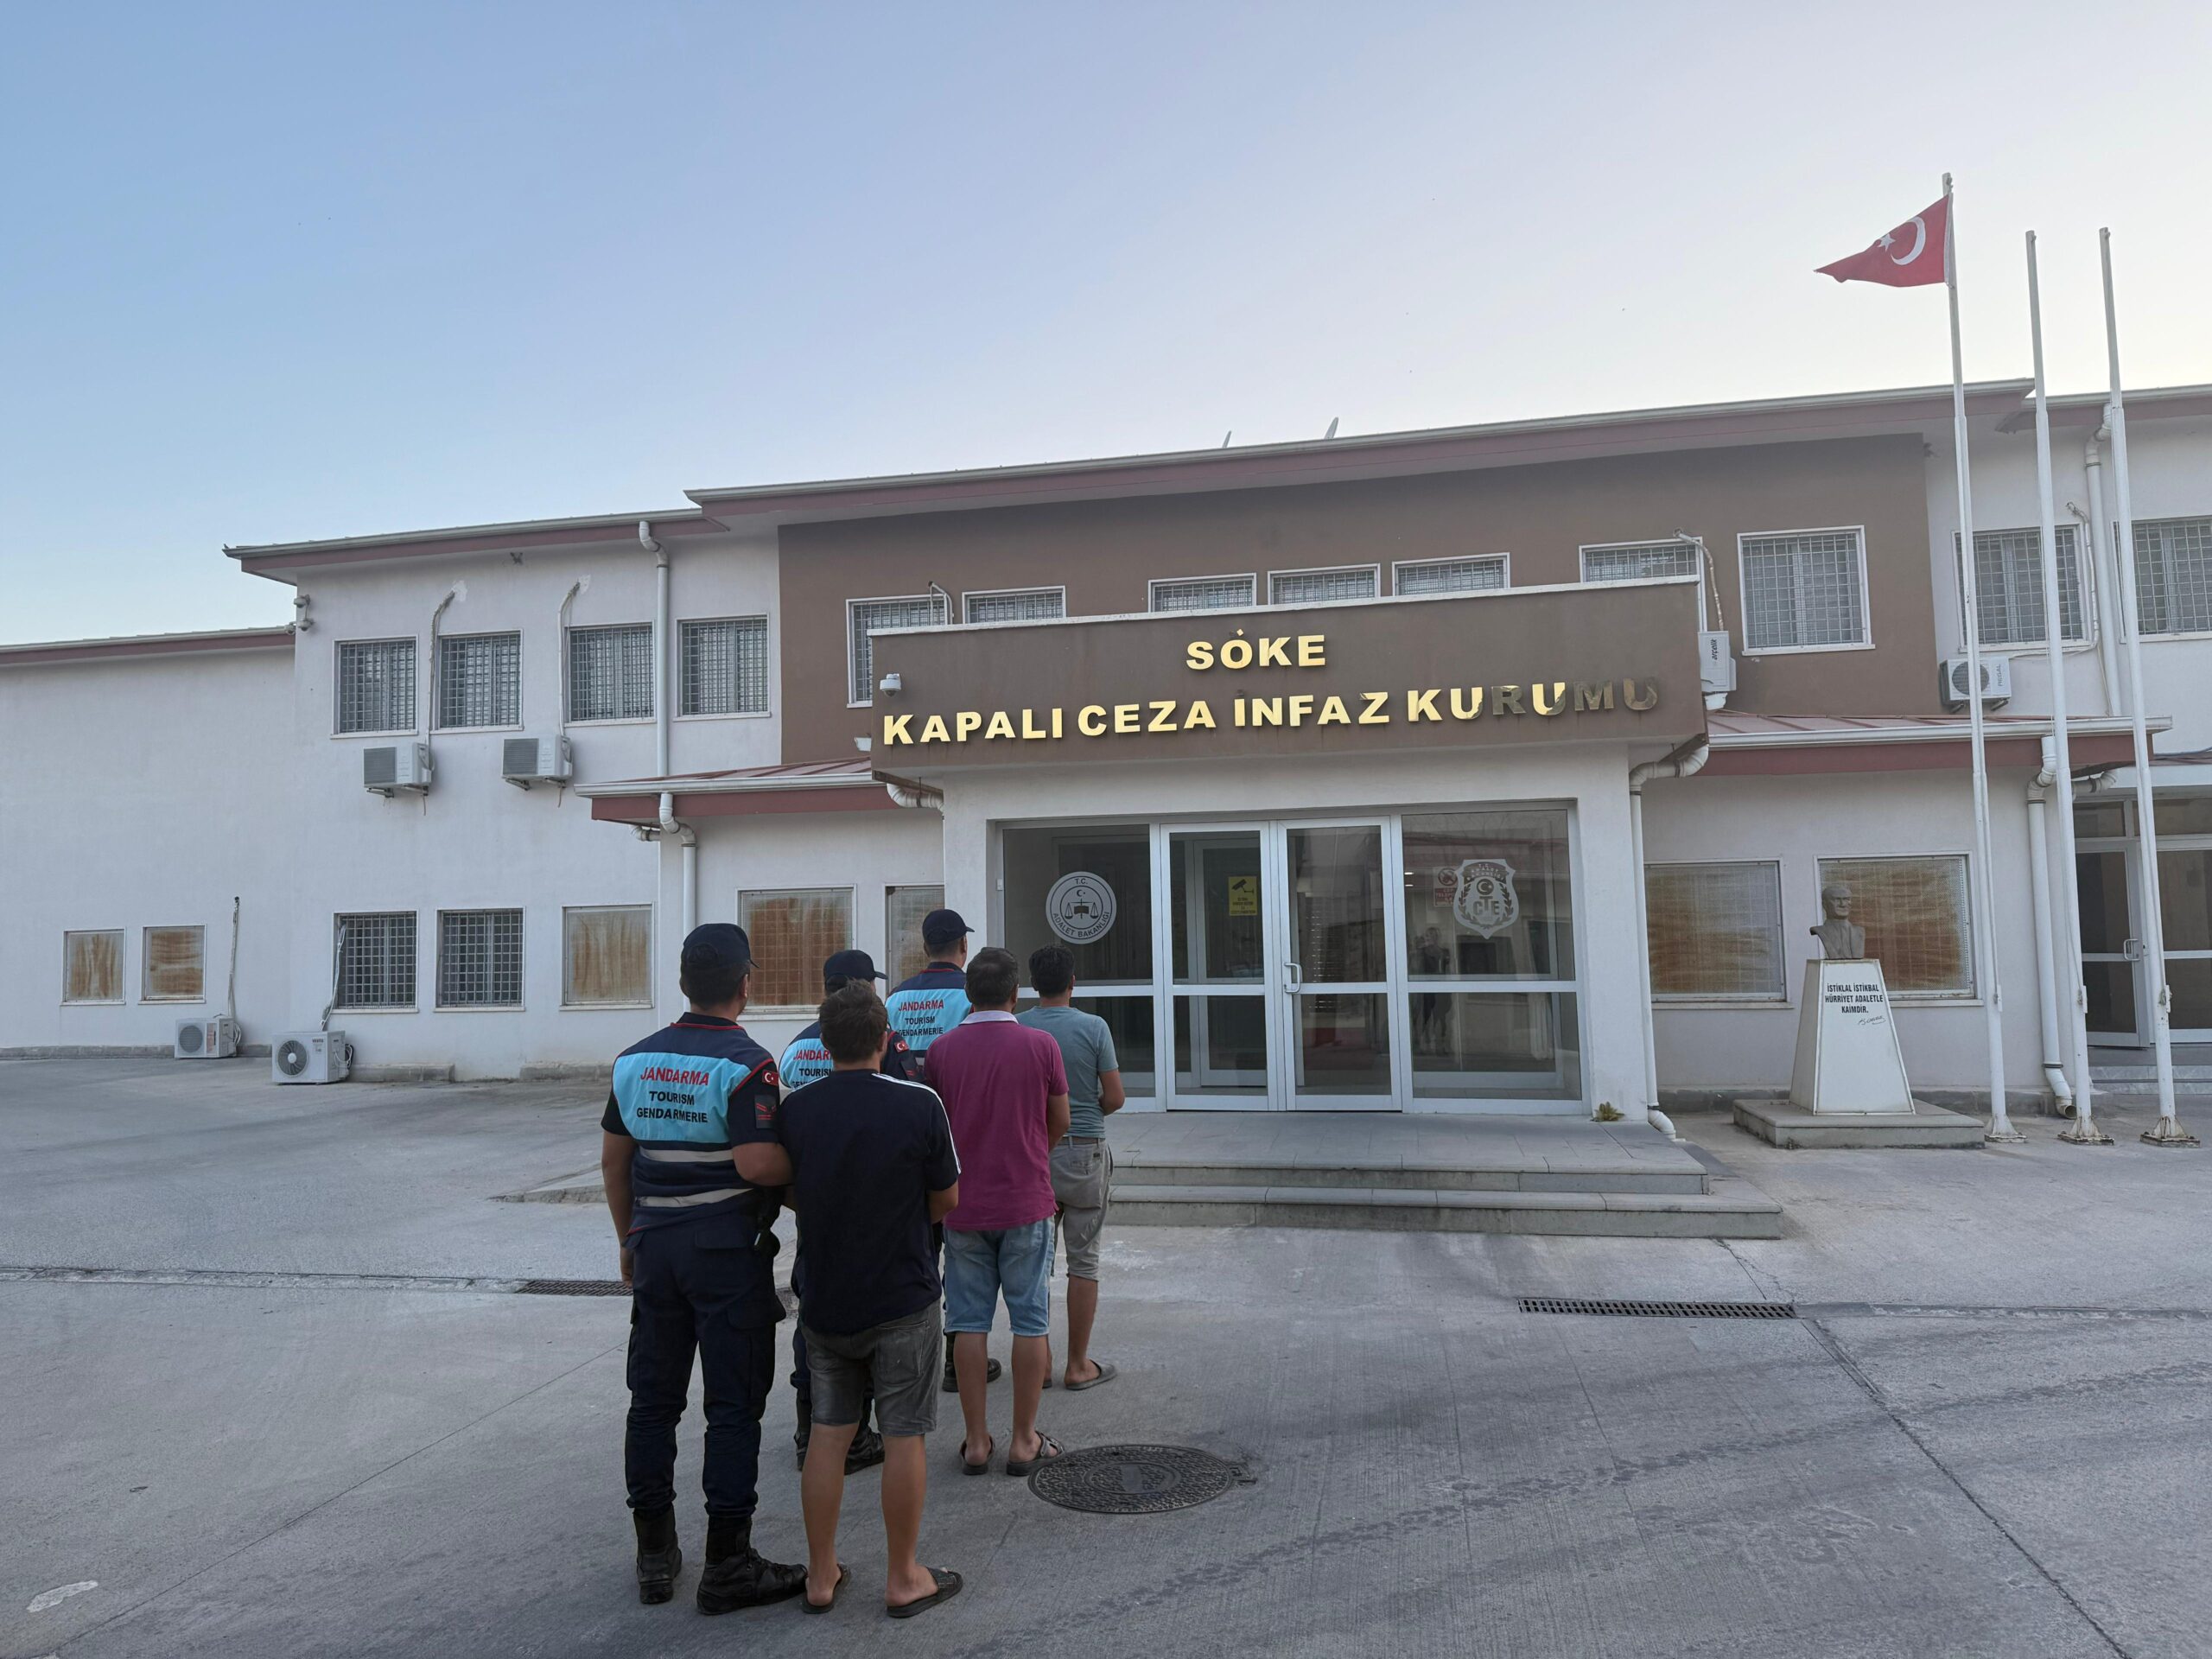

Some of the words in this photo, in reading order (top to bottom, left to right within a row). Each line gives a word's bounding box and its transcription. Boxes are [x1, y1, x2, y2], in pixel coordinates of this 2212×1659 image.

[883, 708, 1063, 746] KAPALI
[1077, 700, 1217, 737] CEZA
[1407, 677, 1659, 723] KURUMU
[1053, 912, 1076, 936] ADALET
[1827, 983, 1853, 992] İSTİKLAL
[1853, 982, 1879, 992] İSTİKBAL
[1825, 994, 1853, 1002] HÜRRİYET
[899, 999, 944, 1012] JANDARMA
[1841, 1004, 1869, 1014] KAİMDİR.
[905, 1016, 936, 1025] TOURISM
[899, 1027, 944, 1037] GENDARMERIE
[793, 1049, 830, 1061] JANDAR
[640, 1066, 709, 1086] JANDARMA
[649, 1090, 695, 1106] TOURISM
[636, 1107, 709, 1123] GENDARMERIE
